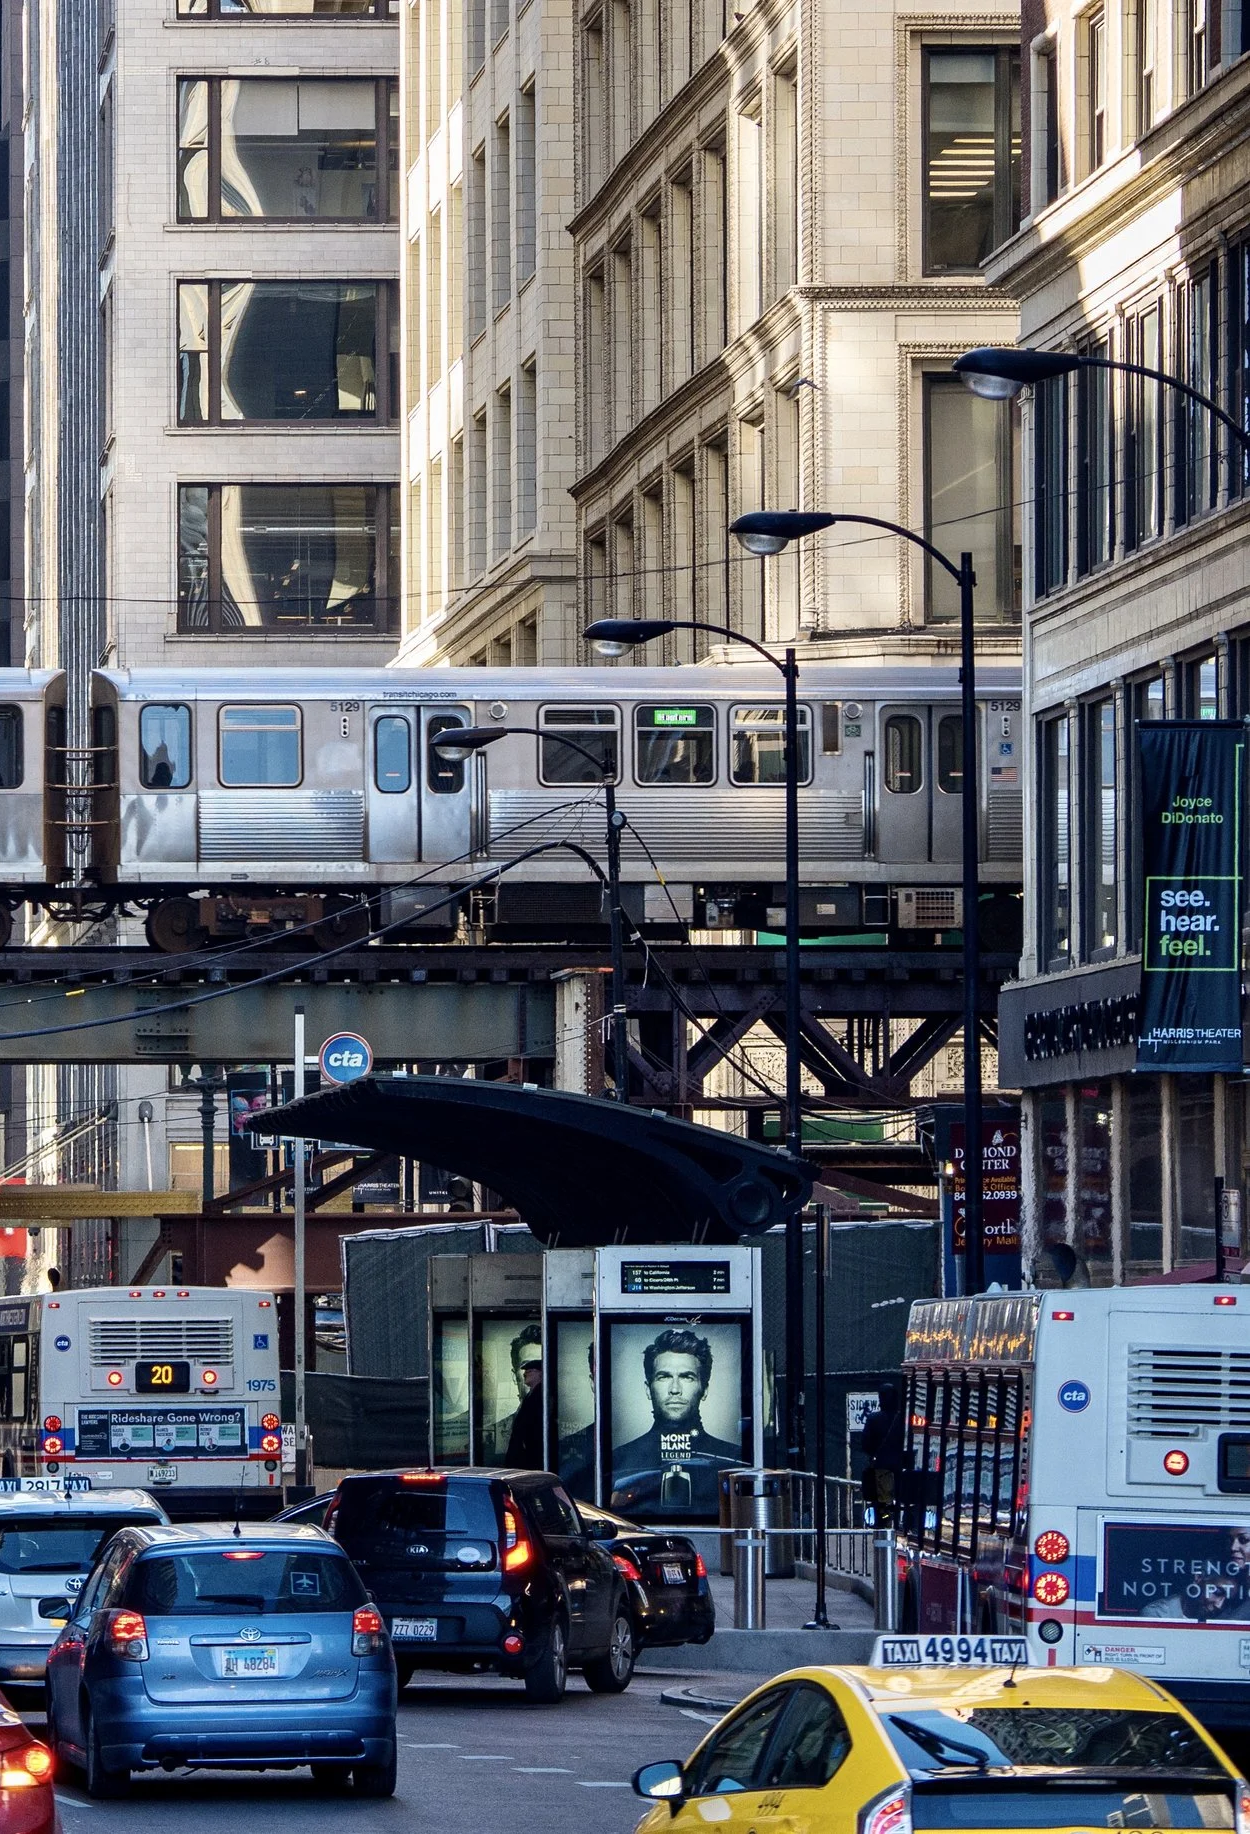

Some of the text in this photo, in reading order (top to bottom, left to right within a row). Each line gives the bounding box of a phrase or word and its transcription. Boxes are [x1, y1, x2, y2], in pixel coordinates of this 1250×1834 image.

[382, 691, 457, 699] transitchicago.com
[330, 701, 360, 712] 5129
[990, 701, 1020, 712] 5129
[1172, 796, 1212, 809] Joyce
[1161, 812, 1224, 824] DiDonato
[1160, 890, 1211, 907] see.
[1160, 910, 1220, 931] hear.
[1159, 935, 1211, 956] feel.
[1153, 1028, 1242, 1038] HARRIS THEATER
[328, 1050, 363, 1067] cta
[996, 1236, 1017, 1245] Mall
[55, 1339, 69, 1347] cta
[150, 1365, 173, 1385] 20
[246, 1380, 276, 1391] 1975
[1063, 1389, 1086, 1402] cta
[111, 1411, 241, 1424] Rideshare Gone Wrong?
[660, 1433, 691, 1442] MONT
[661, 1442, 691, 1450] BLANC
[661, 1451, 691, 1459] LEGEND
[26, 1480, 61, 1491] 2817
[64, 1480, 89, 1490] TAXI
[1123, 1581, 1250, 1599] NOT OPTI
[393, 1625, 434, 1636] ZZ7 0229
[884, 1637, 1026, 1663] TAXI 4994 TAXI
[244, 1657, 276, 1671] 48284
